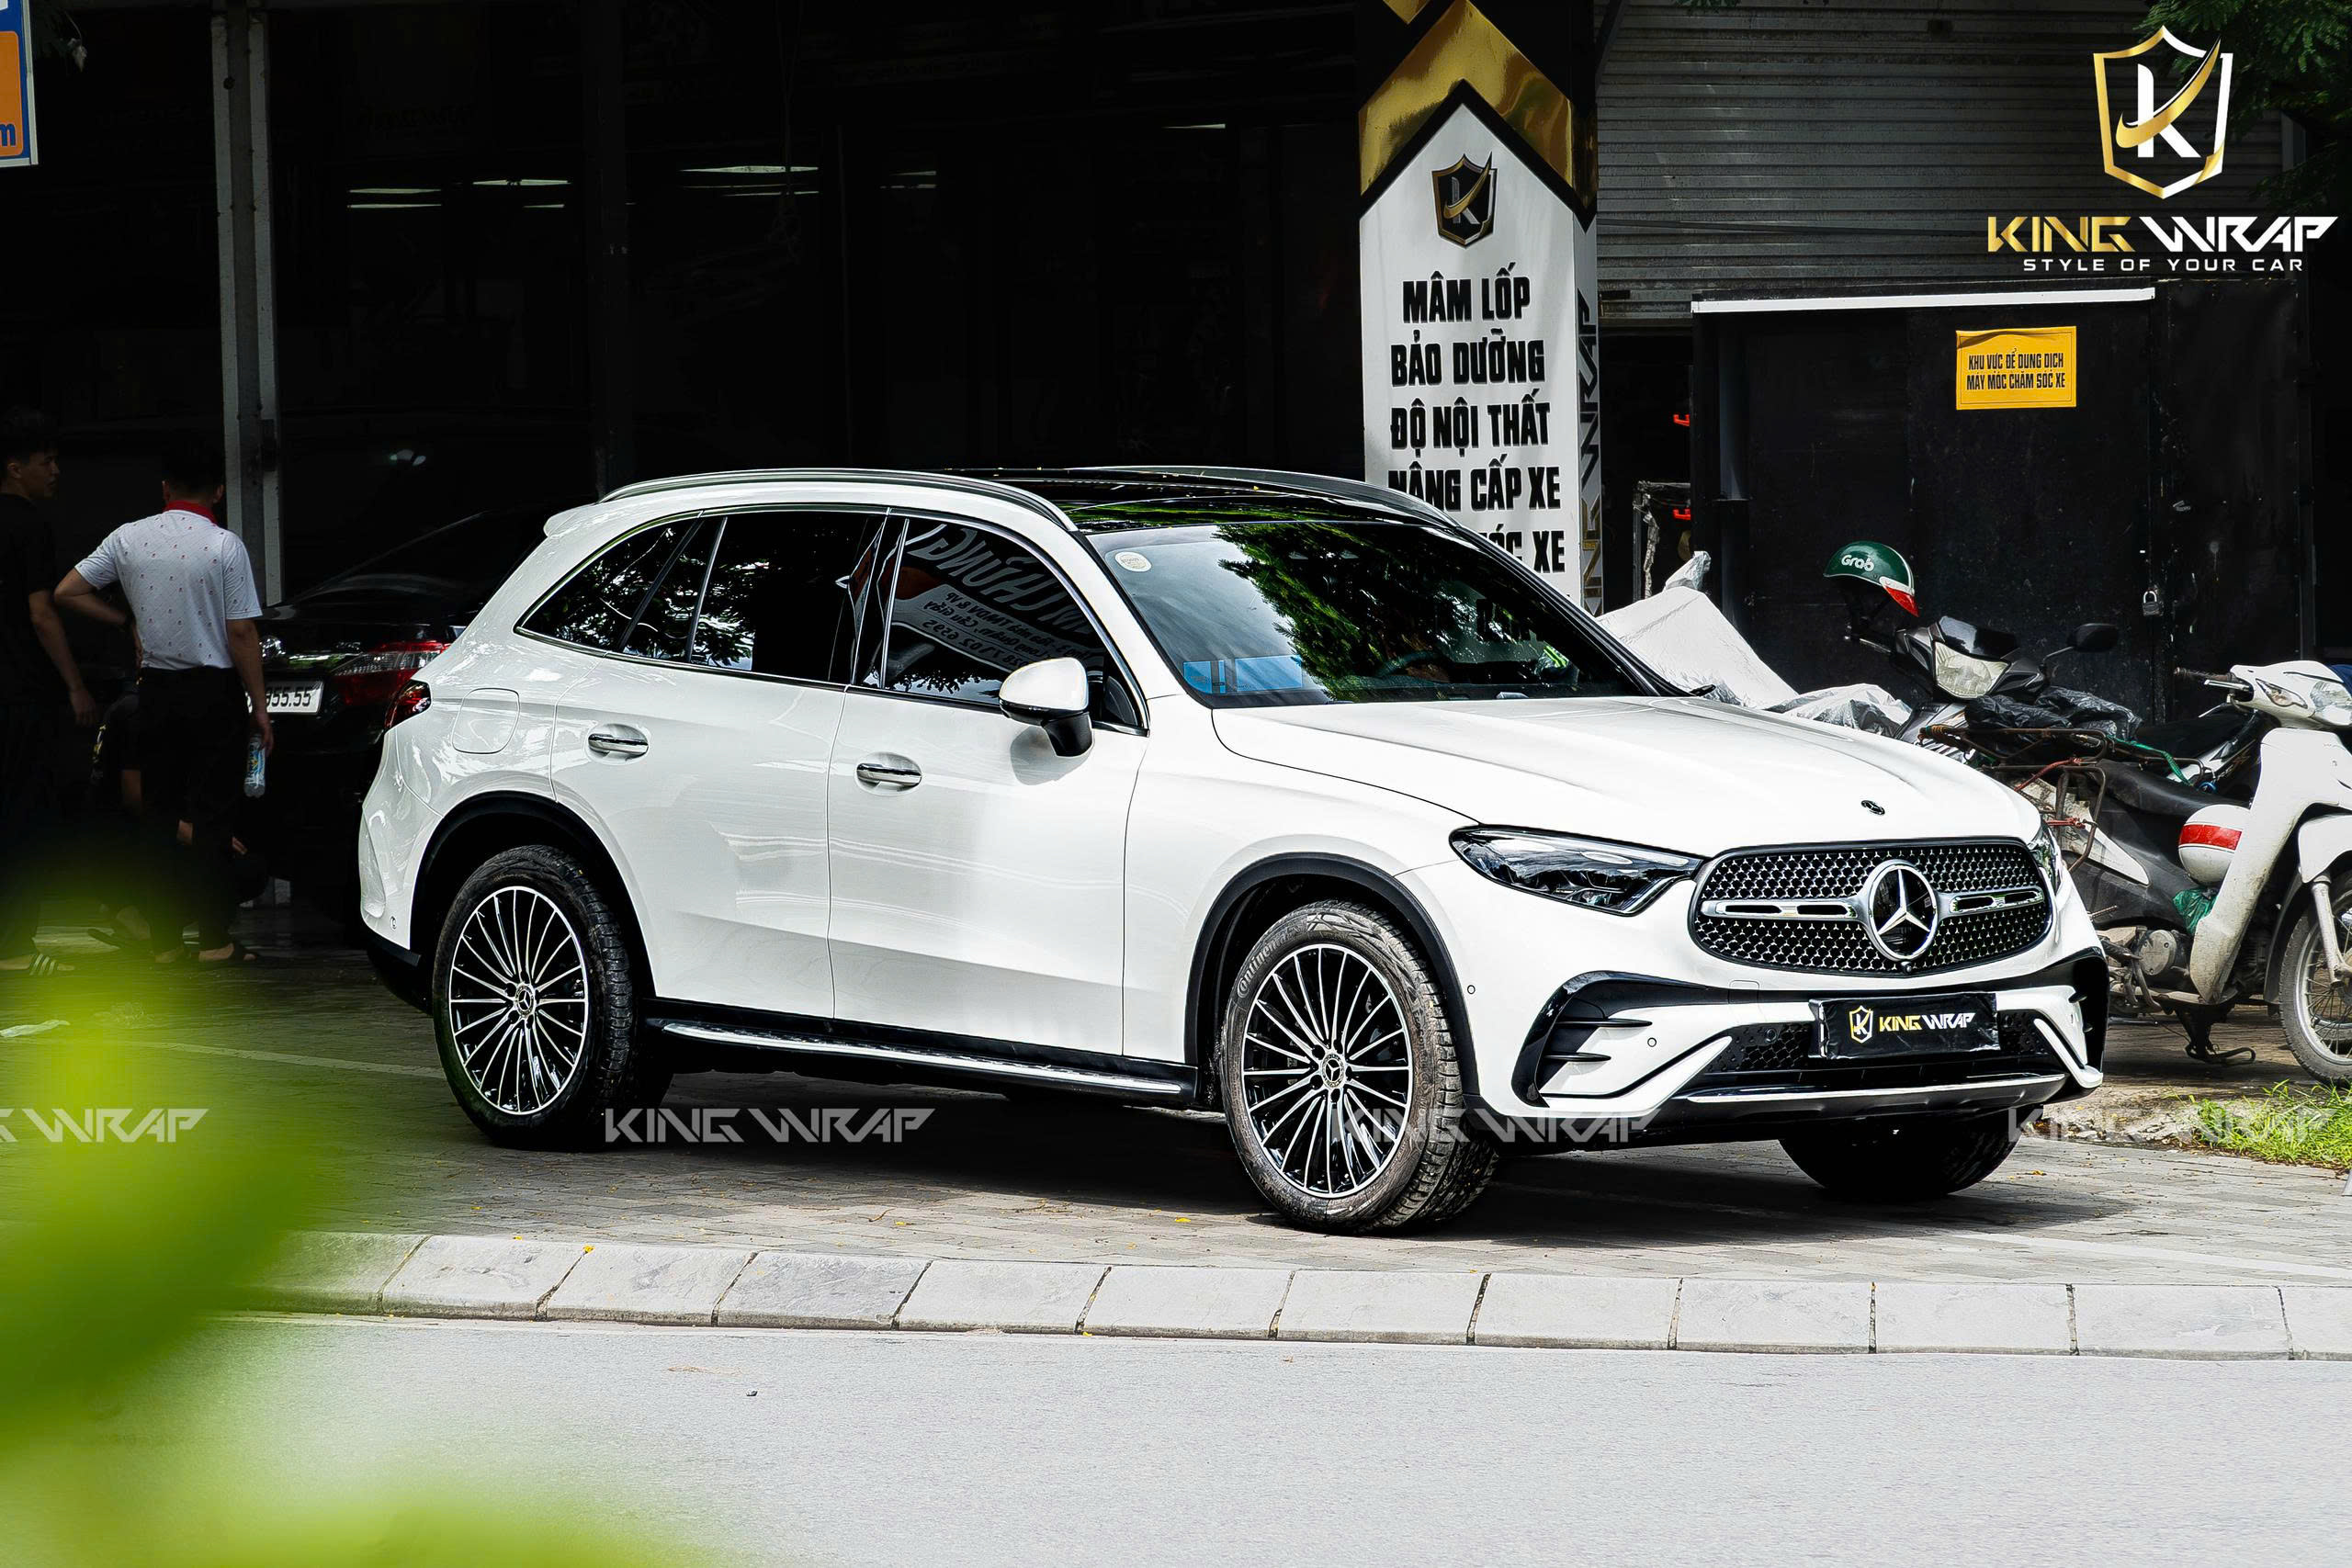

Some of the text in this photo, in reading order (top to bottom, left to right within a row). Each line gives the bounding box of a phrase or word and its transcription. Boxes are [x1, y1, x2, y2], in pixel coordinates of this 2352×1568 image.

[1402, 262, 1531, 323] MÂM LỐP
[1391, 327, 1545, 387] BẢO DƯỠNG
[1968, 355, 1984, 370] KHU
[2006, 347, 2018, 369] ĐỂ
[2018, 353, 2041, 369] DUNG
[2044, 353, 2064, 371] DỊCH
[1967, 369, 2065, 390] MÁY MÓC CHĂM SÓC XE
[1390, 388, 1551, 457] ĐỘ NỘI THẤT
[1470, 454, 1522, 511] CẤP
[1528, 466, 1561, 510] XE
[1532, 530, 1566, 573] XE
[1841, 554, 1875, 571] Grab
[1879, 1015, 1922, 1032] KING
[1922, 1012, 1975, 1030] WRAP
